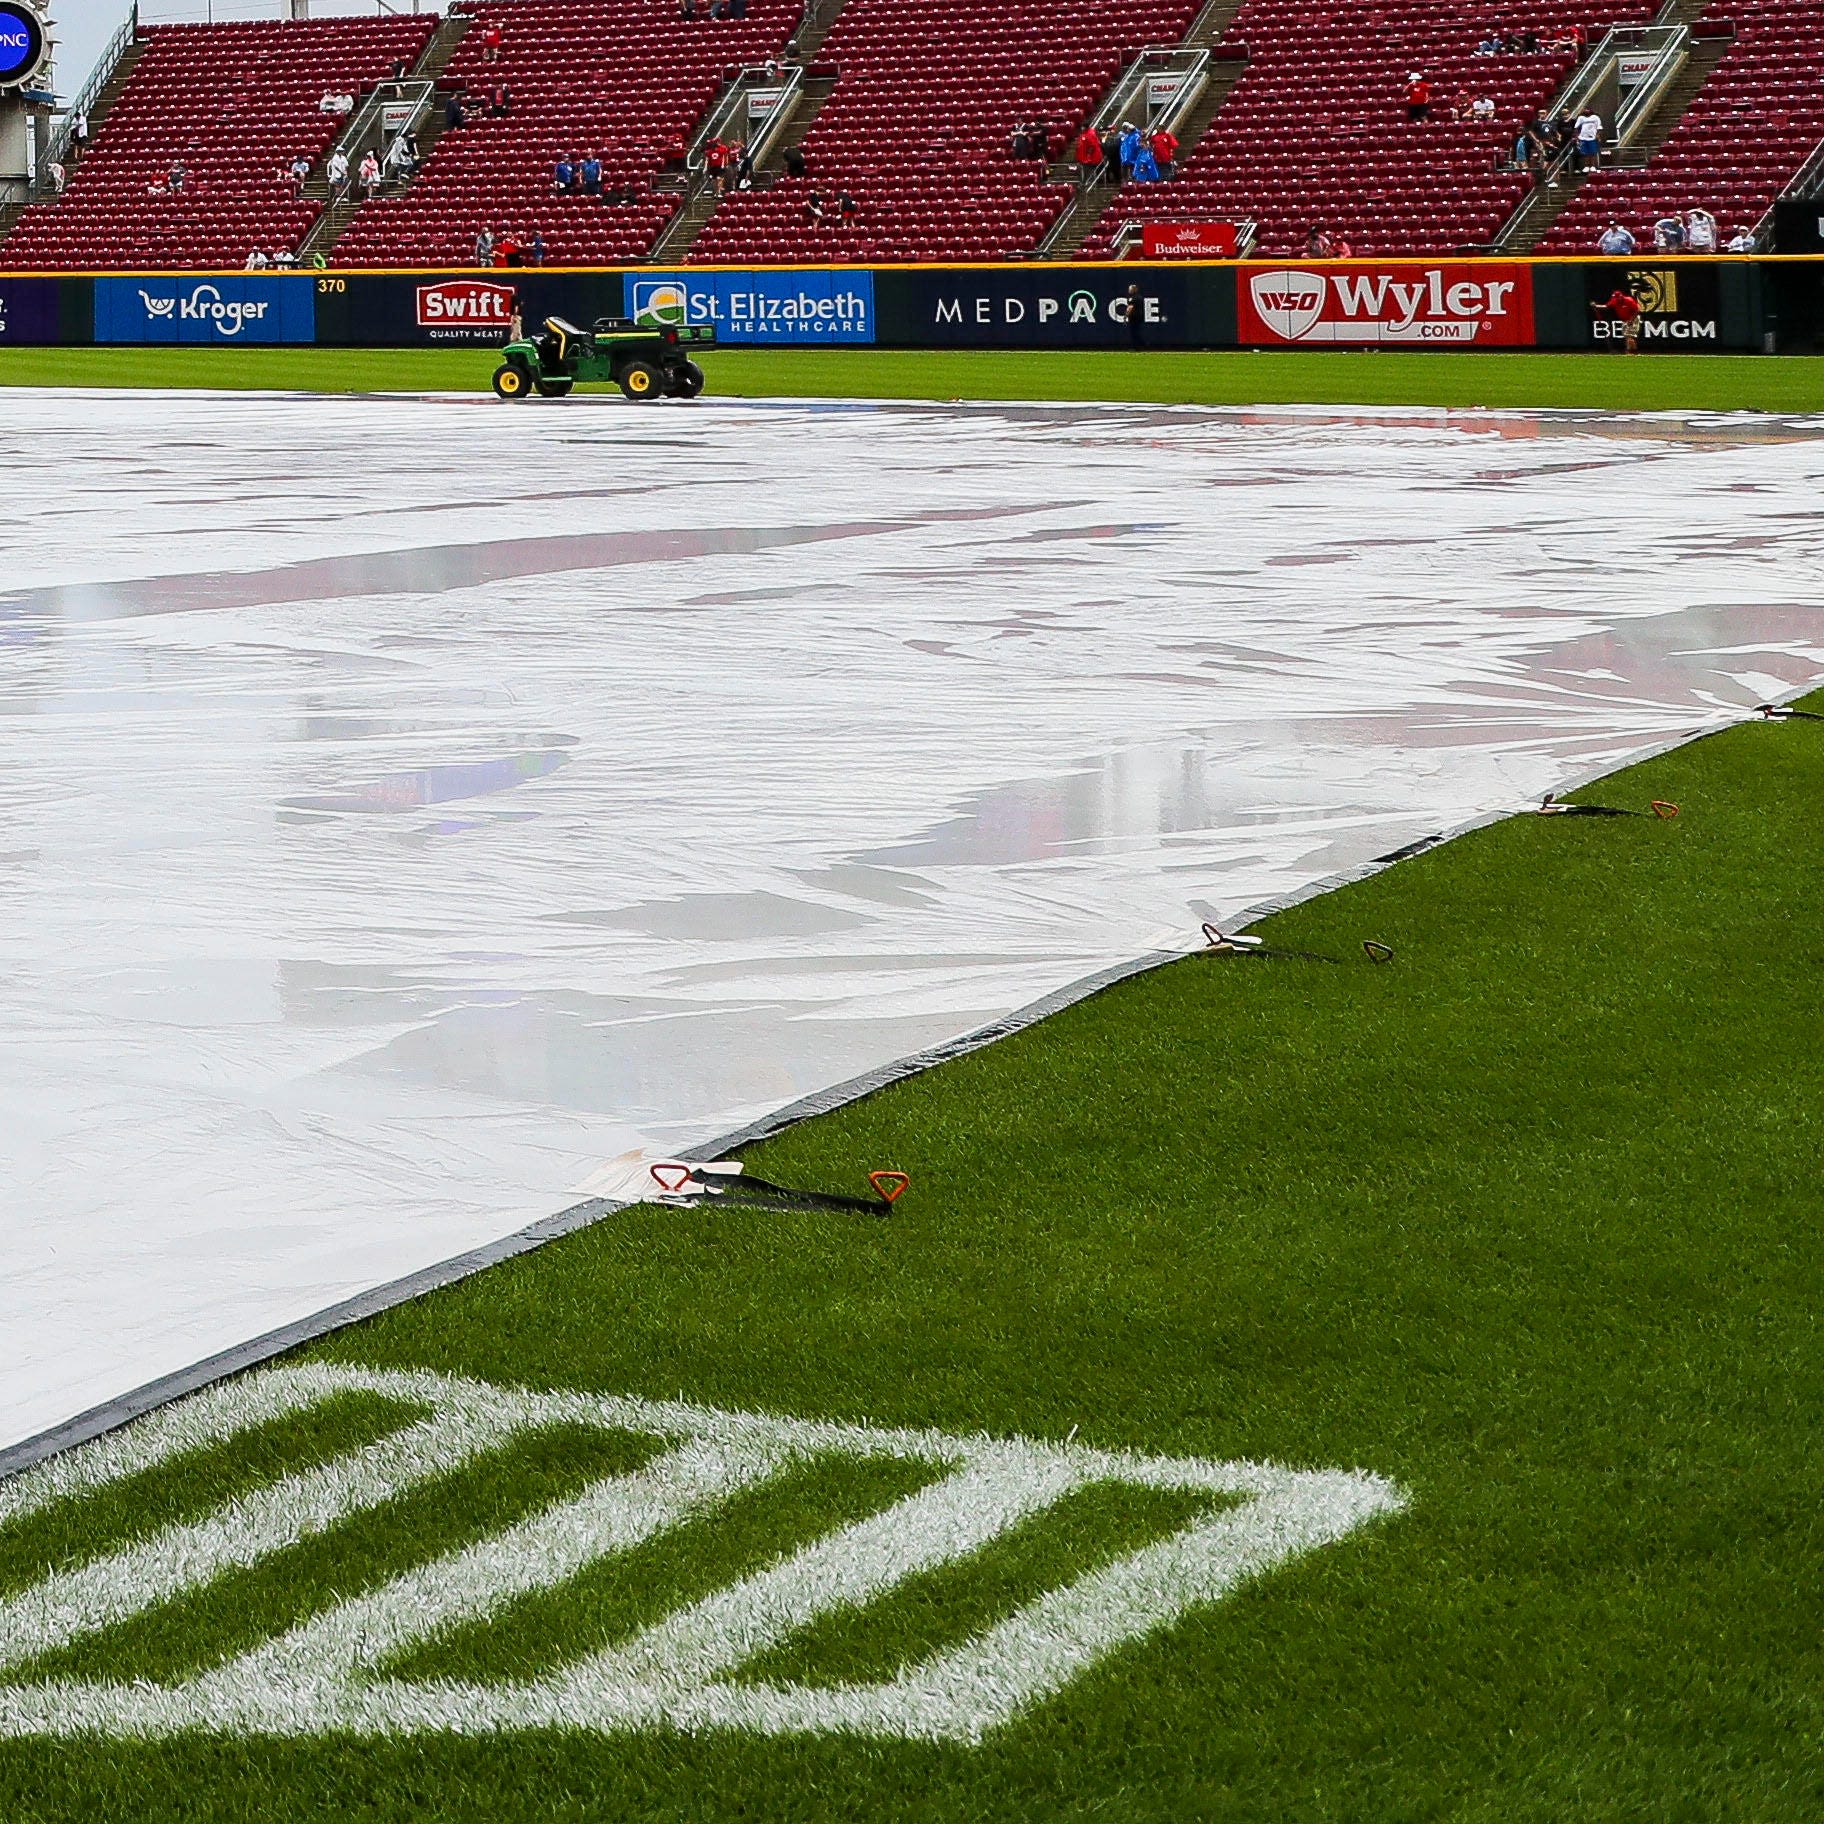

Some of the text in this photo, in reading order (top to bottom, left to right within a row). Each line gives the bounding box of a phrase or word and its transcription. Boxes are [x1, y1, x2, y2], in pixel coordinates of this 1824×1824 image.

[1155, 243, 1223, 254] Budweiser
[318, 280, 345, 293] 370
[426, 291, 506, 317] Swift
[690, 290, 865, 319] St. Elizabeth
[1330, 270, 1514, 332] Wyler
[179, 285, 268, 335] Kroger
[730, 321, 866, 331] HEALTHCARE
[1417, 325, 1460, 338] .COM
[1593, 321, 1716, 338] BEMGM
[429, 330, 503, 338] QUALITY MEATS
